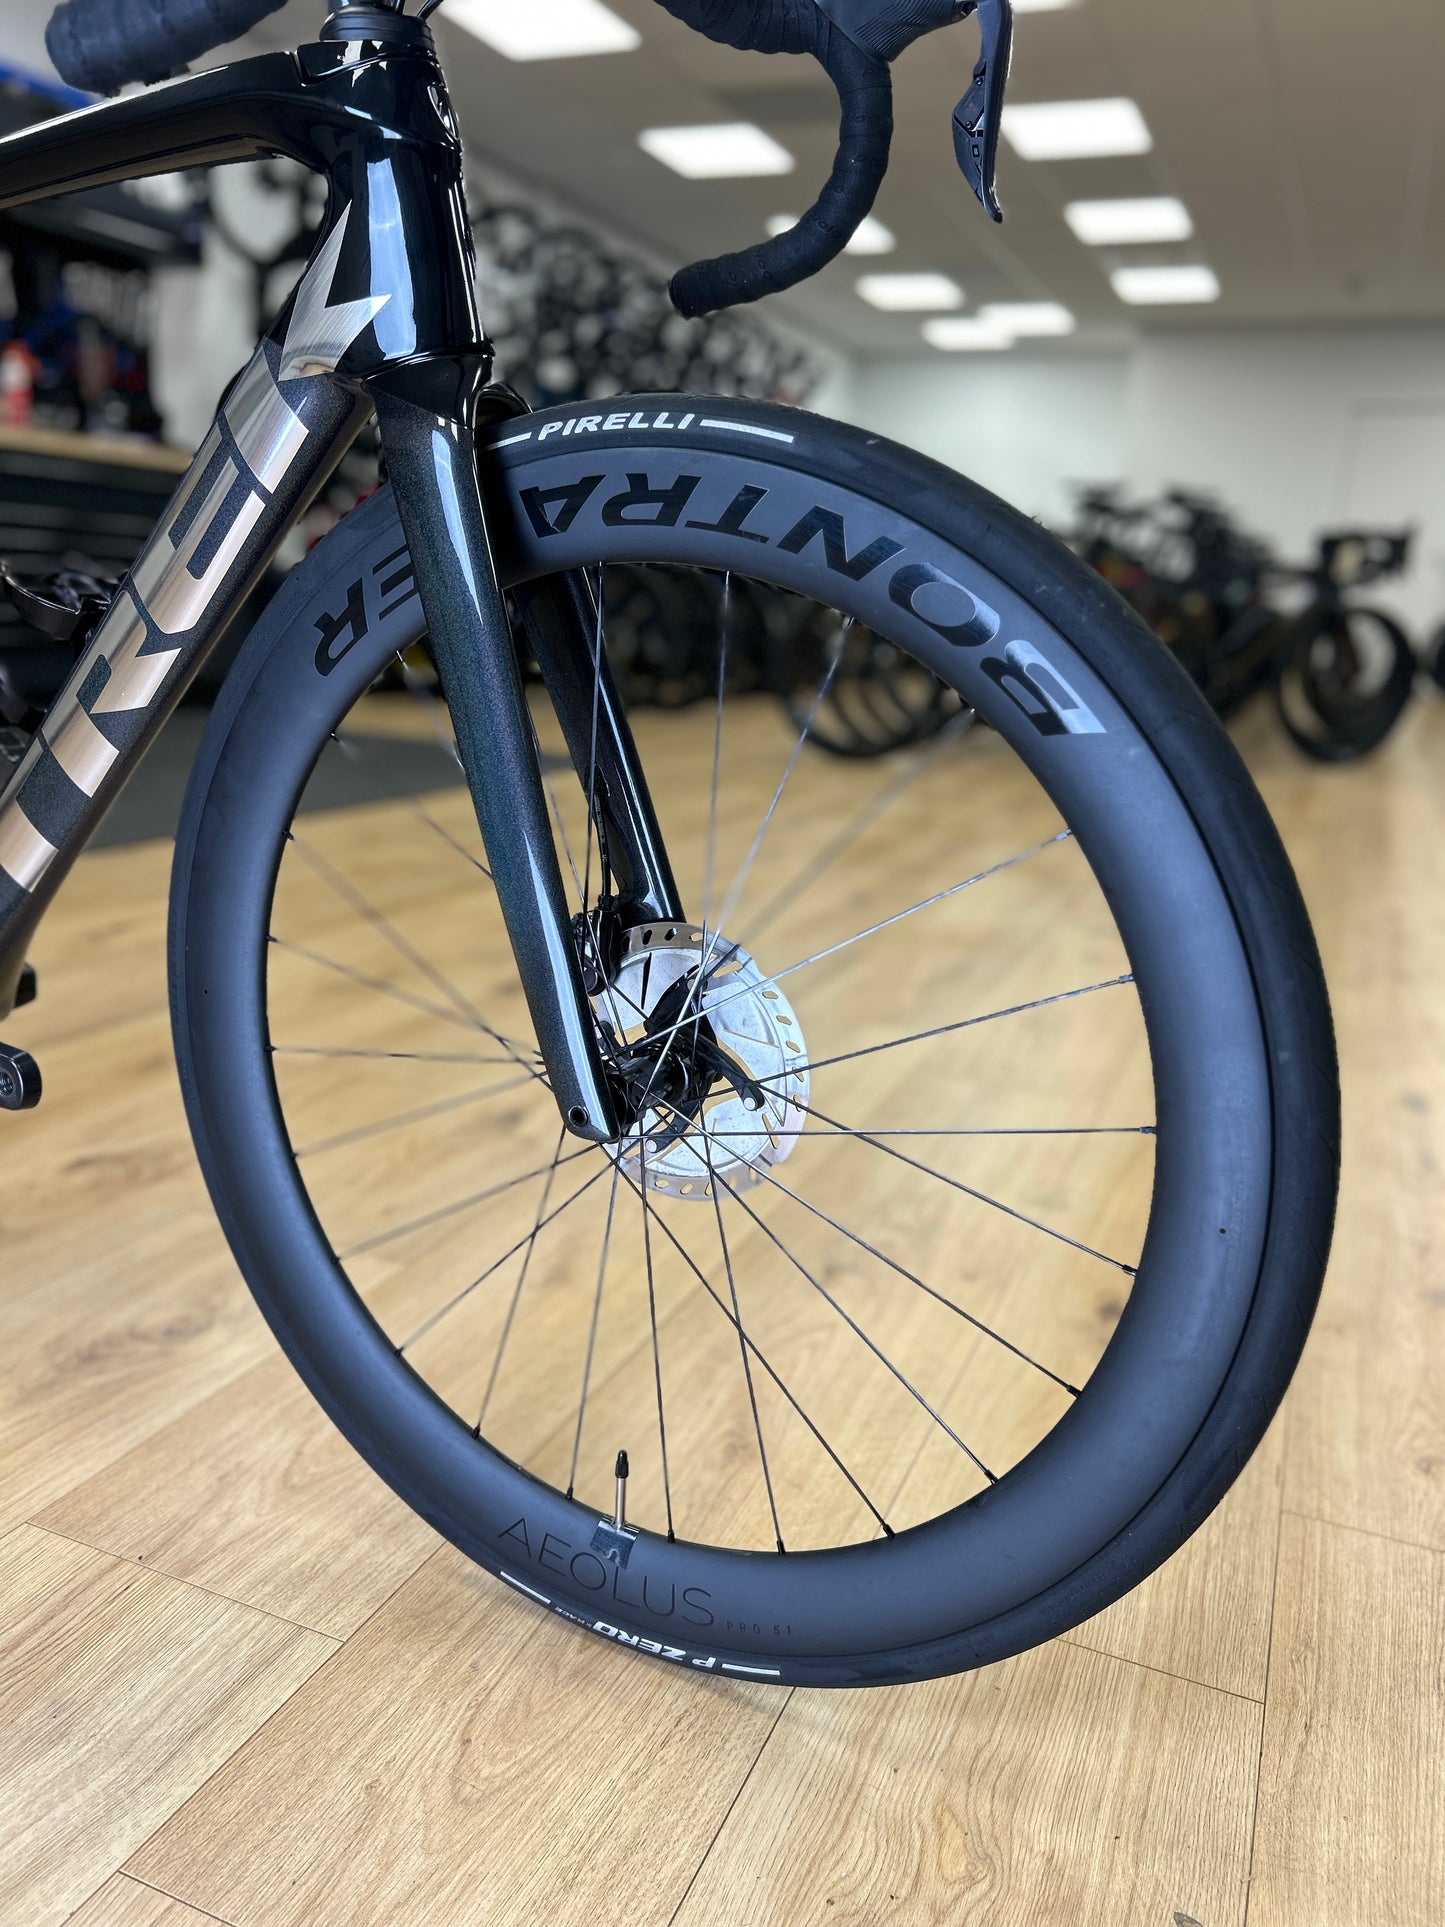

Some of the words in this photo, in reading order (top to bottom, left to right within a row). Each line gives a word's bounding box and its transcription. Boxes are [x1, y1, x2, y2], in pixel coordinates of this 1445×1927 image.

[536, 411, 696, 441] PIRELLI
[314, 472, 1107, 737] BONTRAER
[496, 1516, 715, 1628] AEOLUS
[592, 1620, 687, 1661] ZERO
[726, 1620, 761, 1635] PRO
[773, 1624, 792, 1636] 51
[691, 1656, 717, 1669] P
